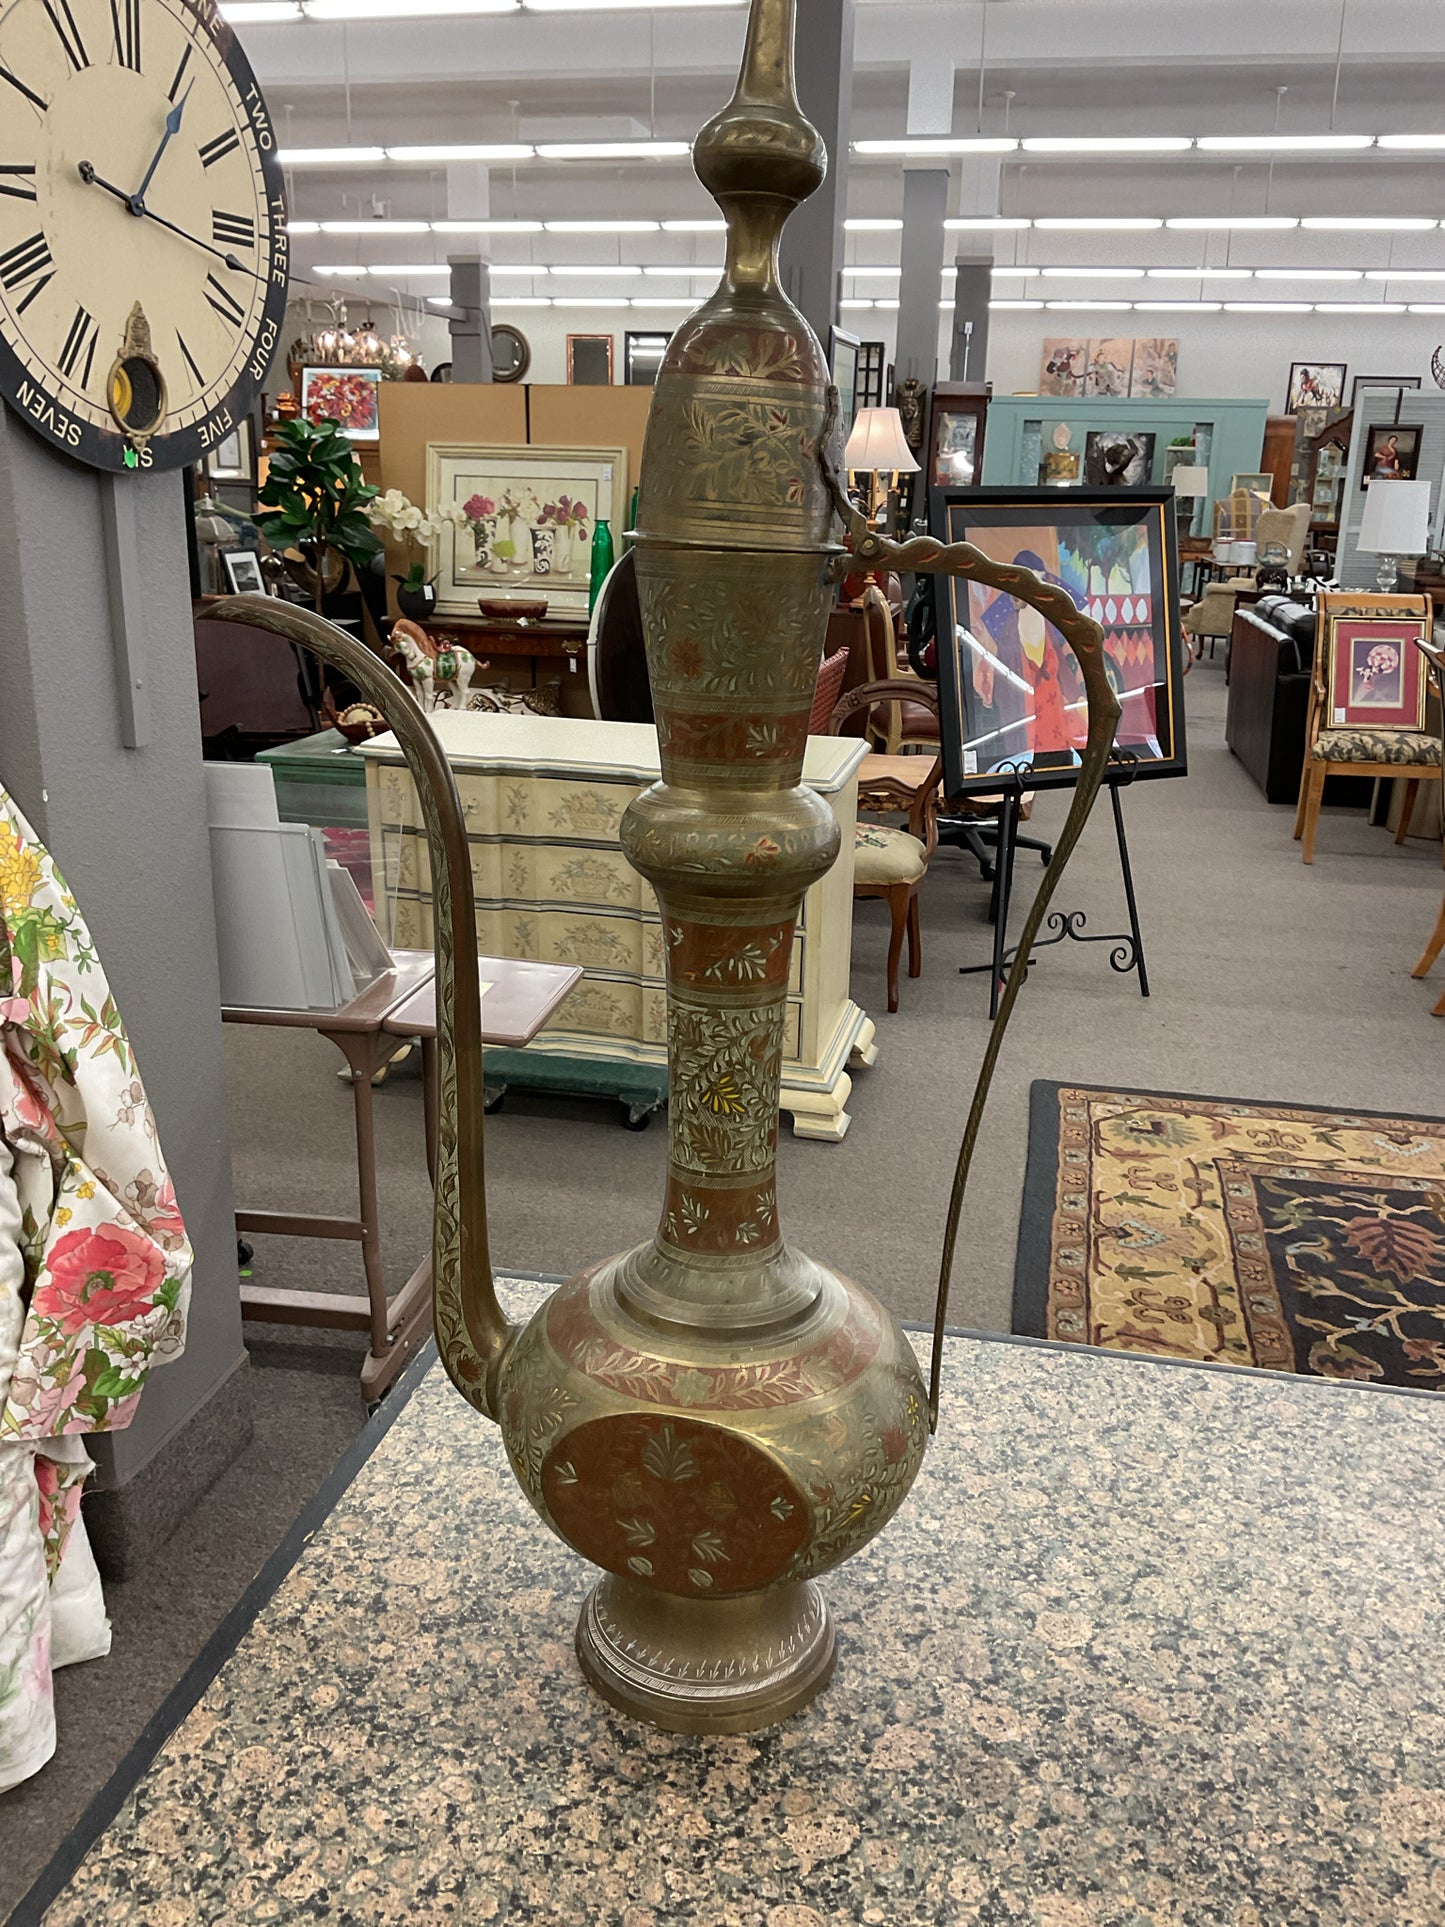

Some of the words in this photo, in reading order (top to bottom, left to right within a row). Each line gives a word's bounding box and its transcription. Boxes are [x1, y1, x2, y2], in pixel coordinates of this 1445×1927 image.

[189, 0, 224, 37] NE
[246, 82, 272, 150] TWO
[271, 194, 287, 288] THREE
[249, 318, 278, 381] FOUR
[15, 380, 82, 447] SEVEN
[197, 407, 233, 448] FIVE
